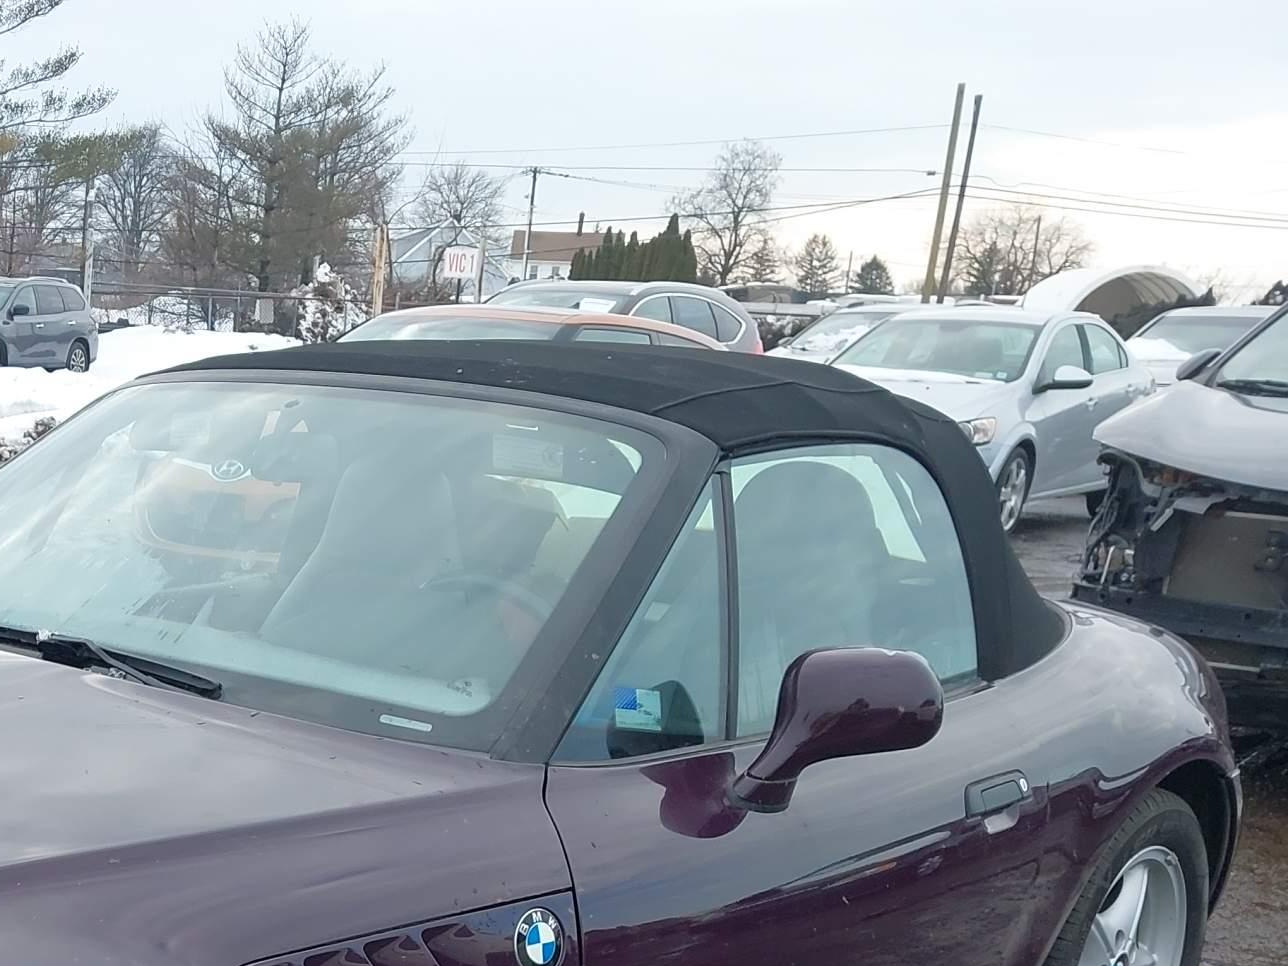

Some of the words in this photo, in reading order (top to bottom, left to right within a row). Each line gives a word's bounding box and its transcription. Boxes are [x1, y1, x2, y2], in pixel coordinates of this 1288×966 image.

[449, 252, 467, 273] VIC
[470, 254, 475, 274] 1
[519, 911, 558, 937] BMW
